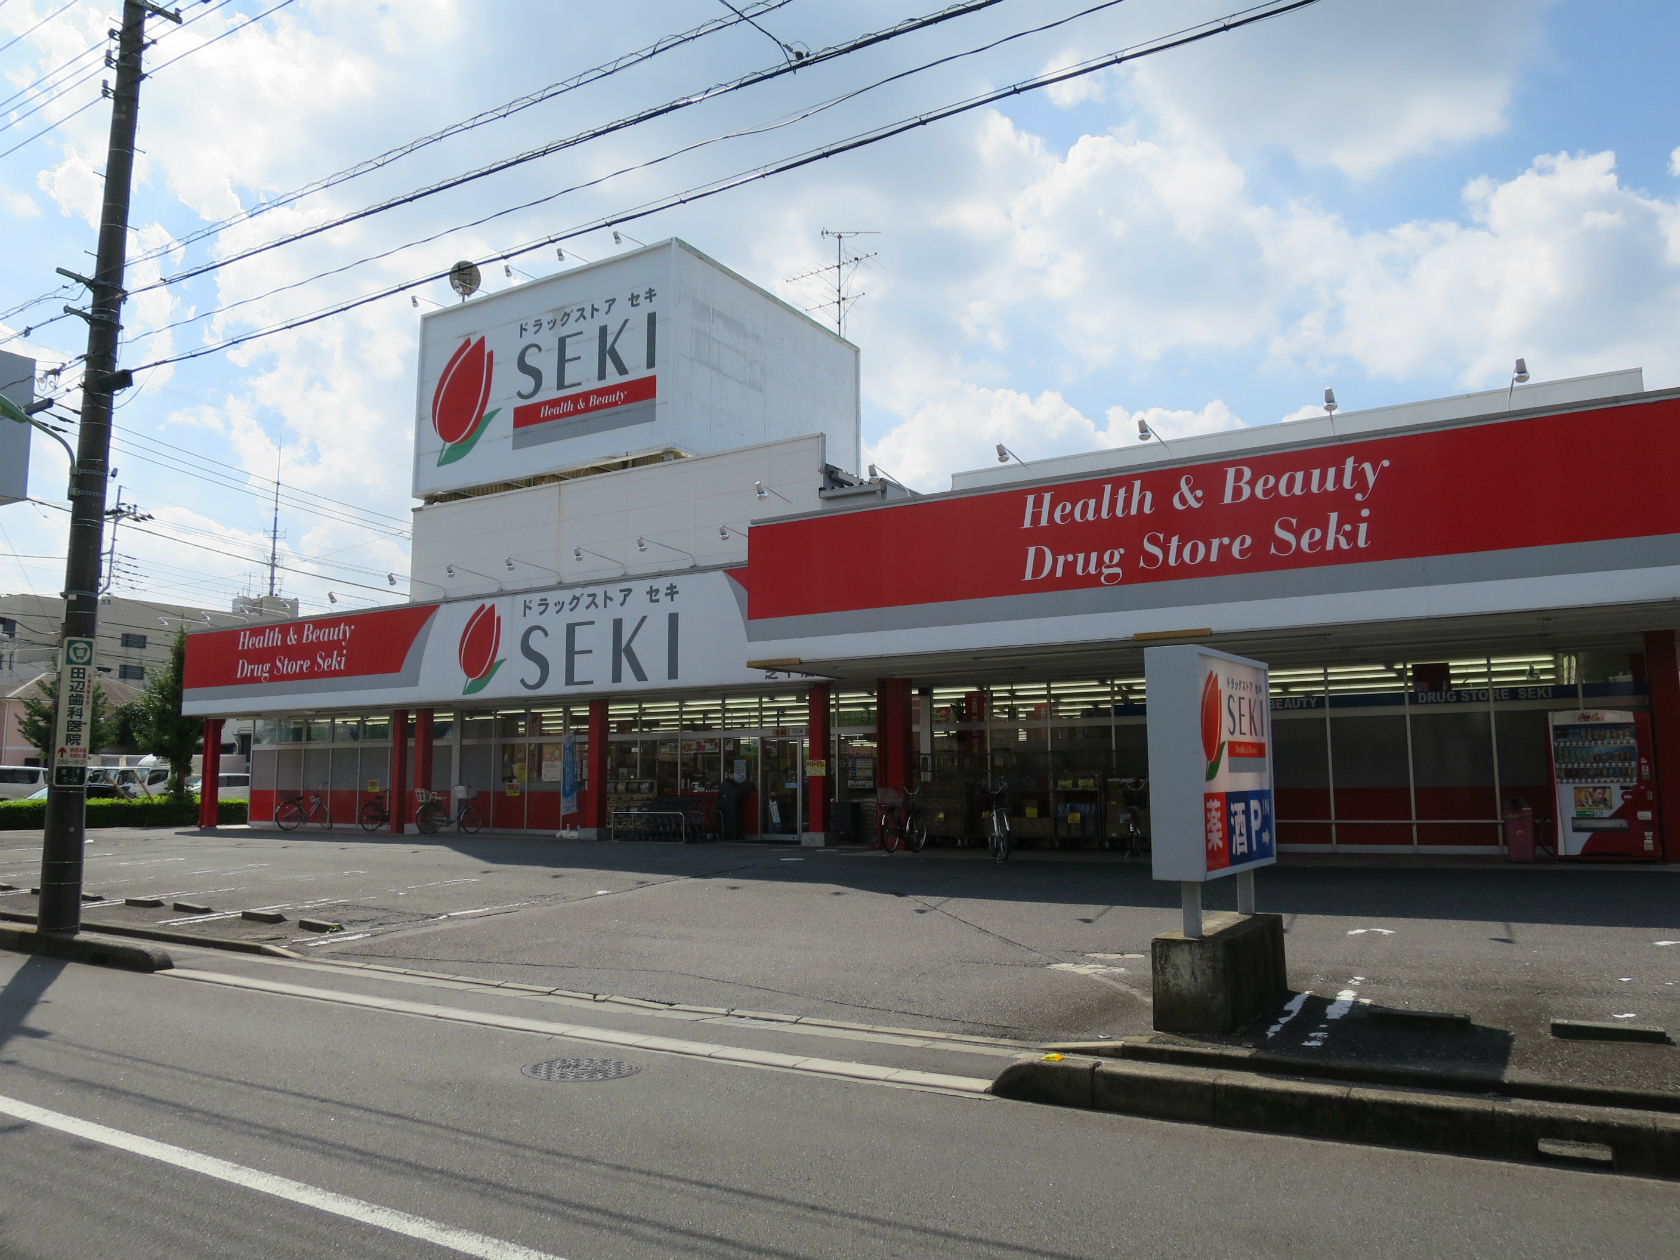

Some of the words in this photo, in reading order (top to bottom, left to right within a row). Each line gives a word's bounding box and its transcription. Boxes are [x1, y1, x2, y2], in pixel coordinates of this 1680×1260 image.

[519, 298, 617, 338] ドラッグストア
[628, 287, 657, 308] セキ
[516, 311, 657, 400] SEKI
[540, 400, 574, 418] Health
[577, 398, 586, 410] &
[589, 390, 627, 407] Beauty
[1020, 479, 1155, 529] Health
[1172, 474, 1204, 511] &
[1219, 455, 1390, 504] Beauty
[1021, 545, 1125, 585] Drug
[1139, 532, 1252, 569] Store
[1270, 508, 1371, 556] Seki
[523, 587, 633, 617] ドラッグストア
[646, 582, 679, 603] セキ
[237, 627, 282, 650] Health
[287, 626, 298, 645] &
[301, 622, 355, 645] Beauty
[519, 612, 679, 691] SEKI
[236, 659, 271, 682] Drug
[274, 655, 310, 675] Store
[314, 649, 347, 672] Seki
[65, 667, 86, 746] 田辺歯科医院
[1227, 694, 1264, 737] SEKI
[1270, 697, 1317, 710] BEAUTY
[1418, 690, 1457, 703] DRUG
[1461, 689, 1510, 702] STORE
[1518, 687, 1553, 699] SEKI
[1206, 799, 1223, 851] 薬
[1231, 802, 1248, 856] 酒
[1250, 799, 1262, 851] P
[1262, 798, 1270, 815] IN
